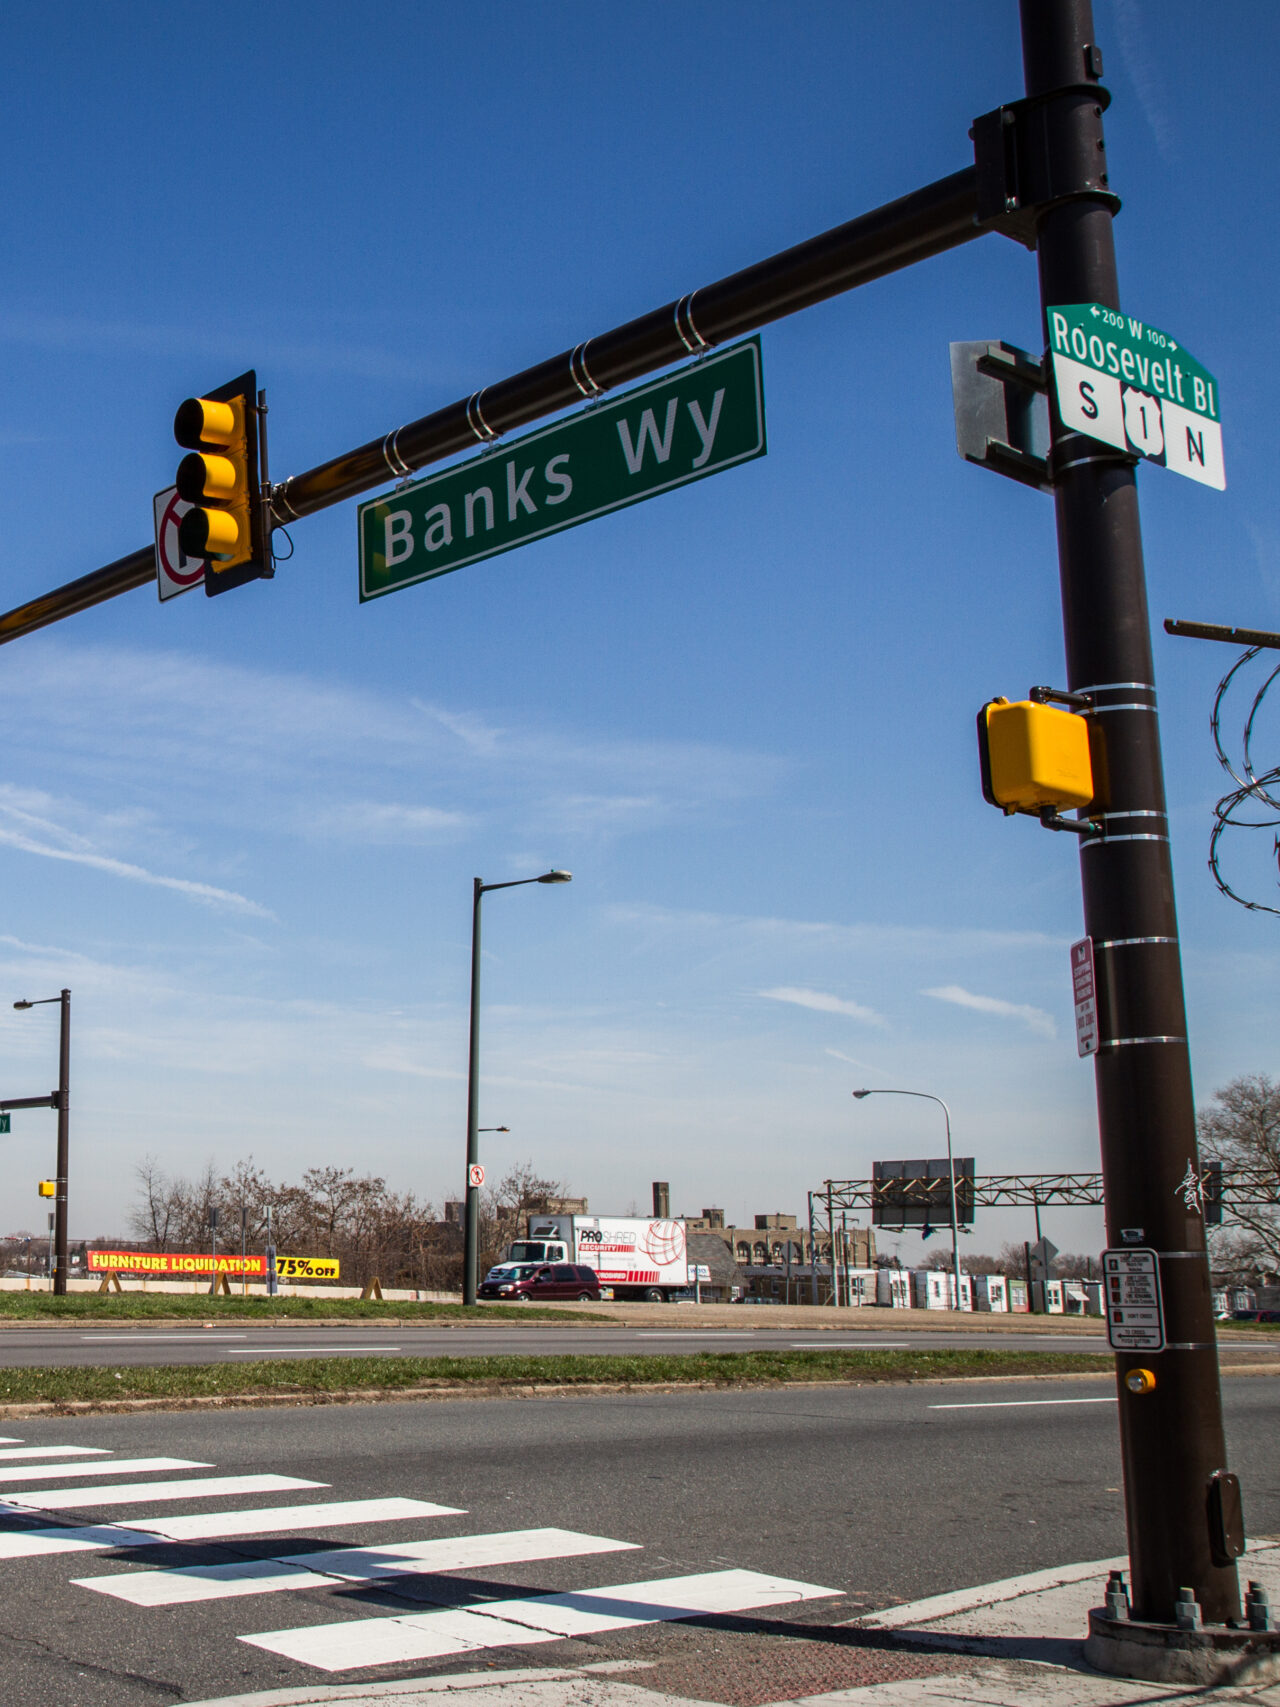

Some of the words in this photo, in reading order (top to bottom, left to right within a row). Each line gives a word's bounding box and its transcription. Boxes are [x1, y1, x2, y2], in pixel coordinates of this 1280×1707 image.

[1102, 310, 1124, 329] 200
[1128, 318, 1142, 340] W
[1146, 330, 1166, 348] 100
[1053, 312, 1184, 403] Roosevelt
[1193, 376, 1216, 416] Bl
[1079, 381, 1099, 420] S
[1140, 406, 1148, 439] 1
[1186, 426, 1205, 467] N
[384, 453, 573, 568] Banks
[617, 388, 725, 475] Wy
[92, 1254, 168, 1270] FURNITURE
[172, 1257, 261, 1272] LIQUIDATION
[580, 1244, 617, 1252] SECURITY
[276, 1260, 314, 1276] 75%
[315, 1267, 336, 1276] OFF
